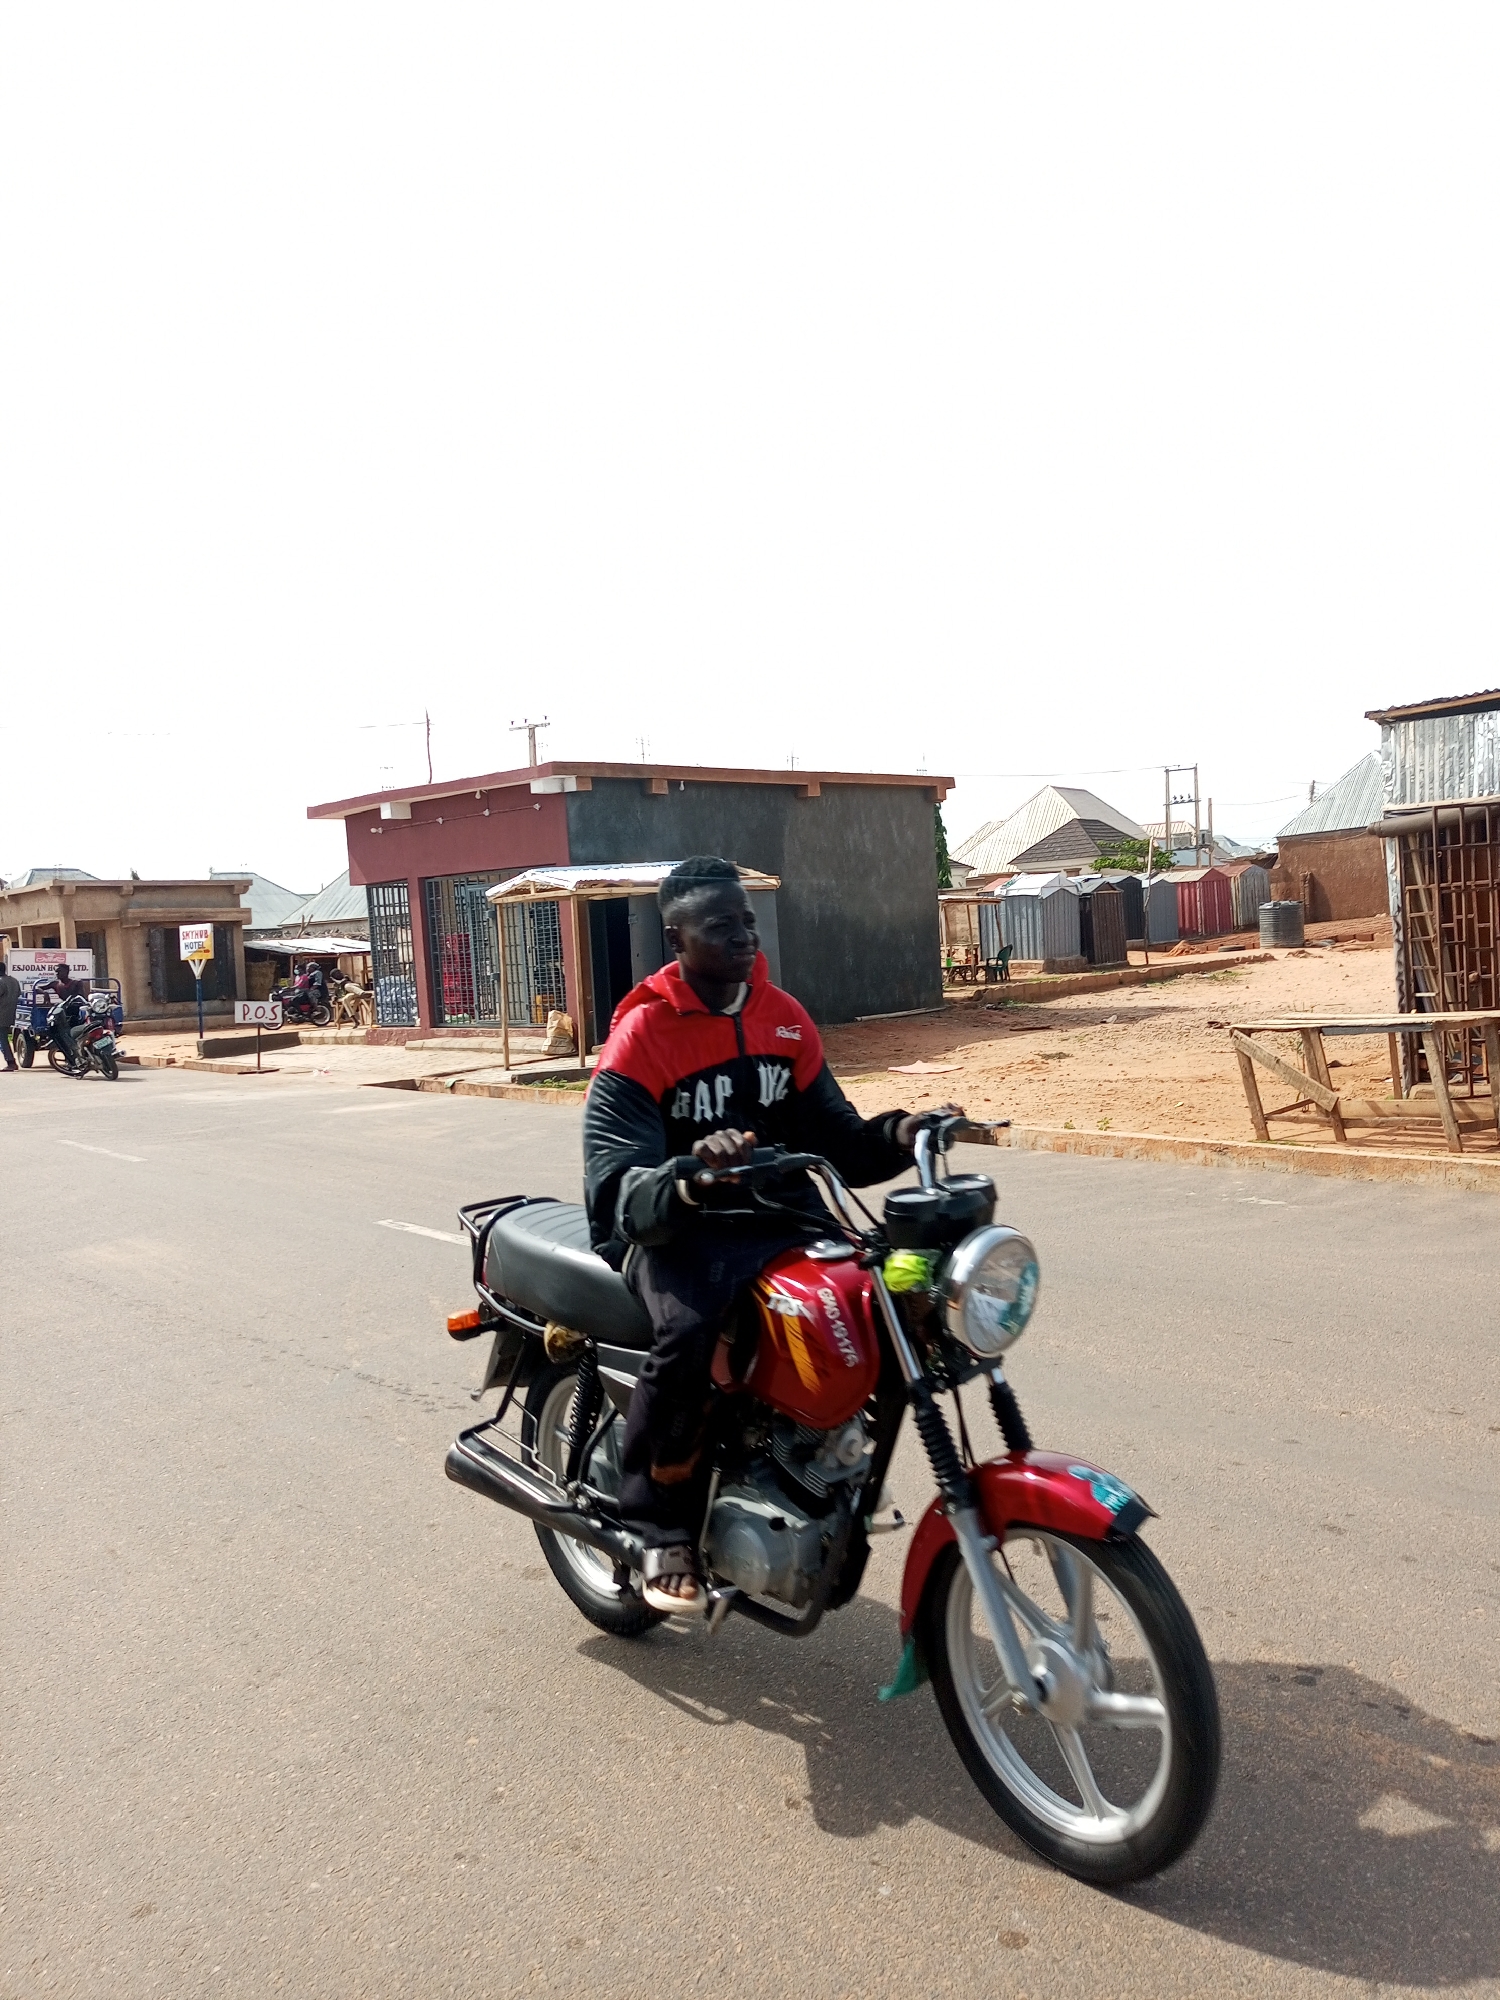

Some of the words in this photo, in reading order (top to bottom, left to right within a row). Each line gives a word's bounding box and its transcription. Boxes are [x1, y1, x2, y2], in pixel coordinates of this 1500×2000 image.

[184, 941, 206, 950] HOTEL
[12, 964, 46, 972] ESJODAN
[243, 1004, 280, 1021] P.O.S
